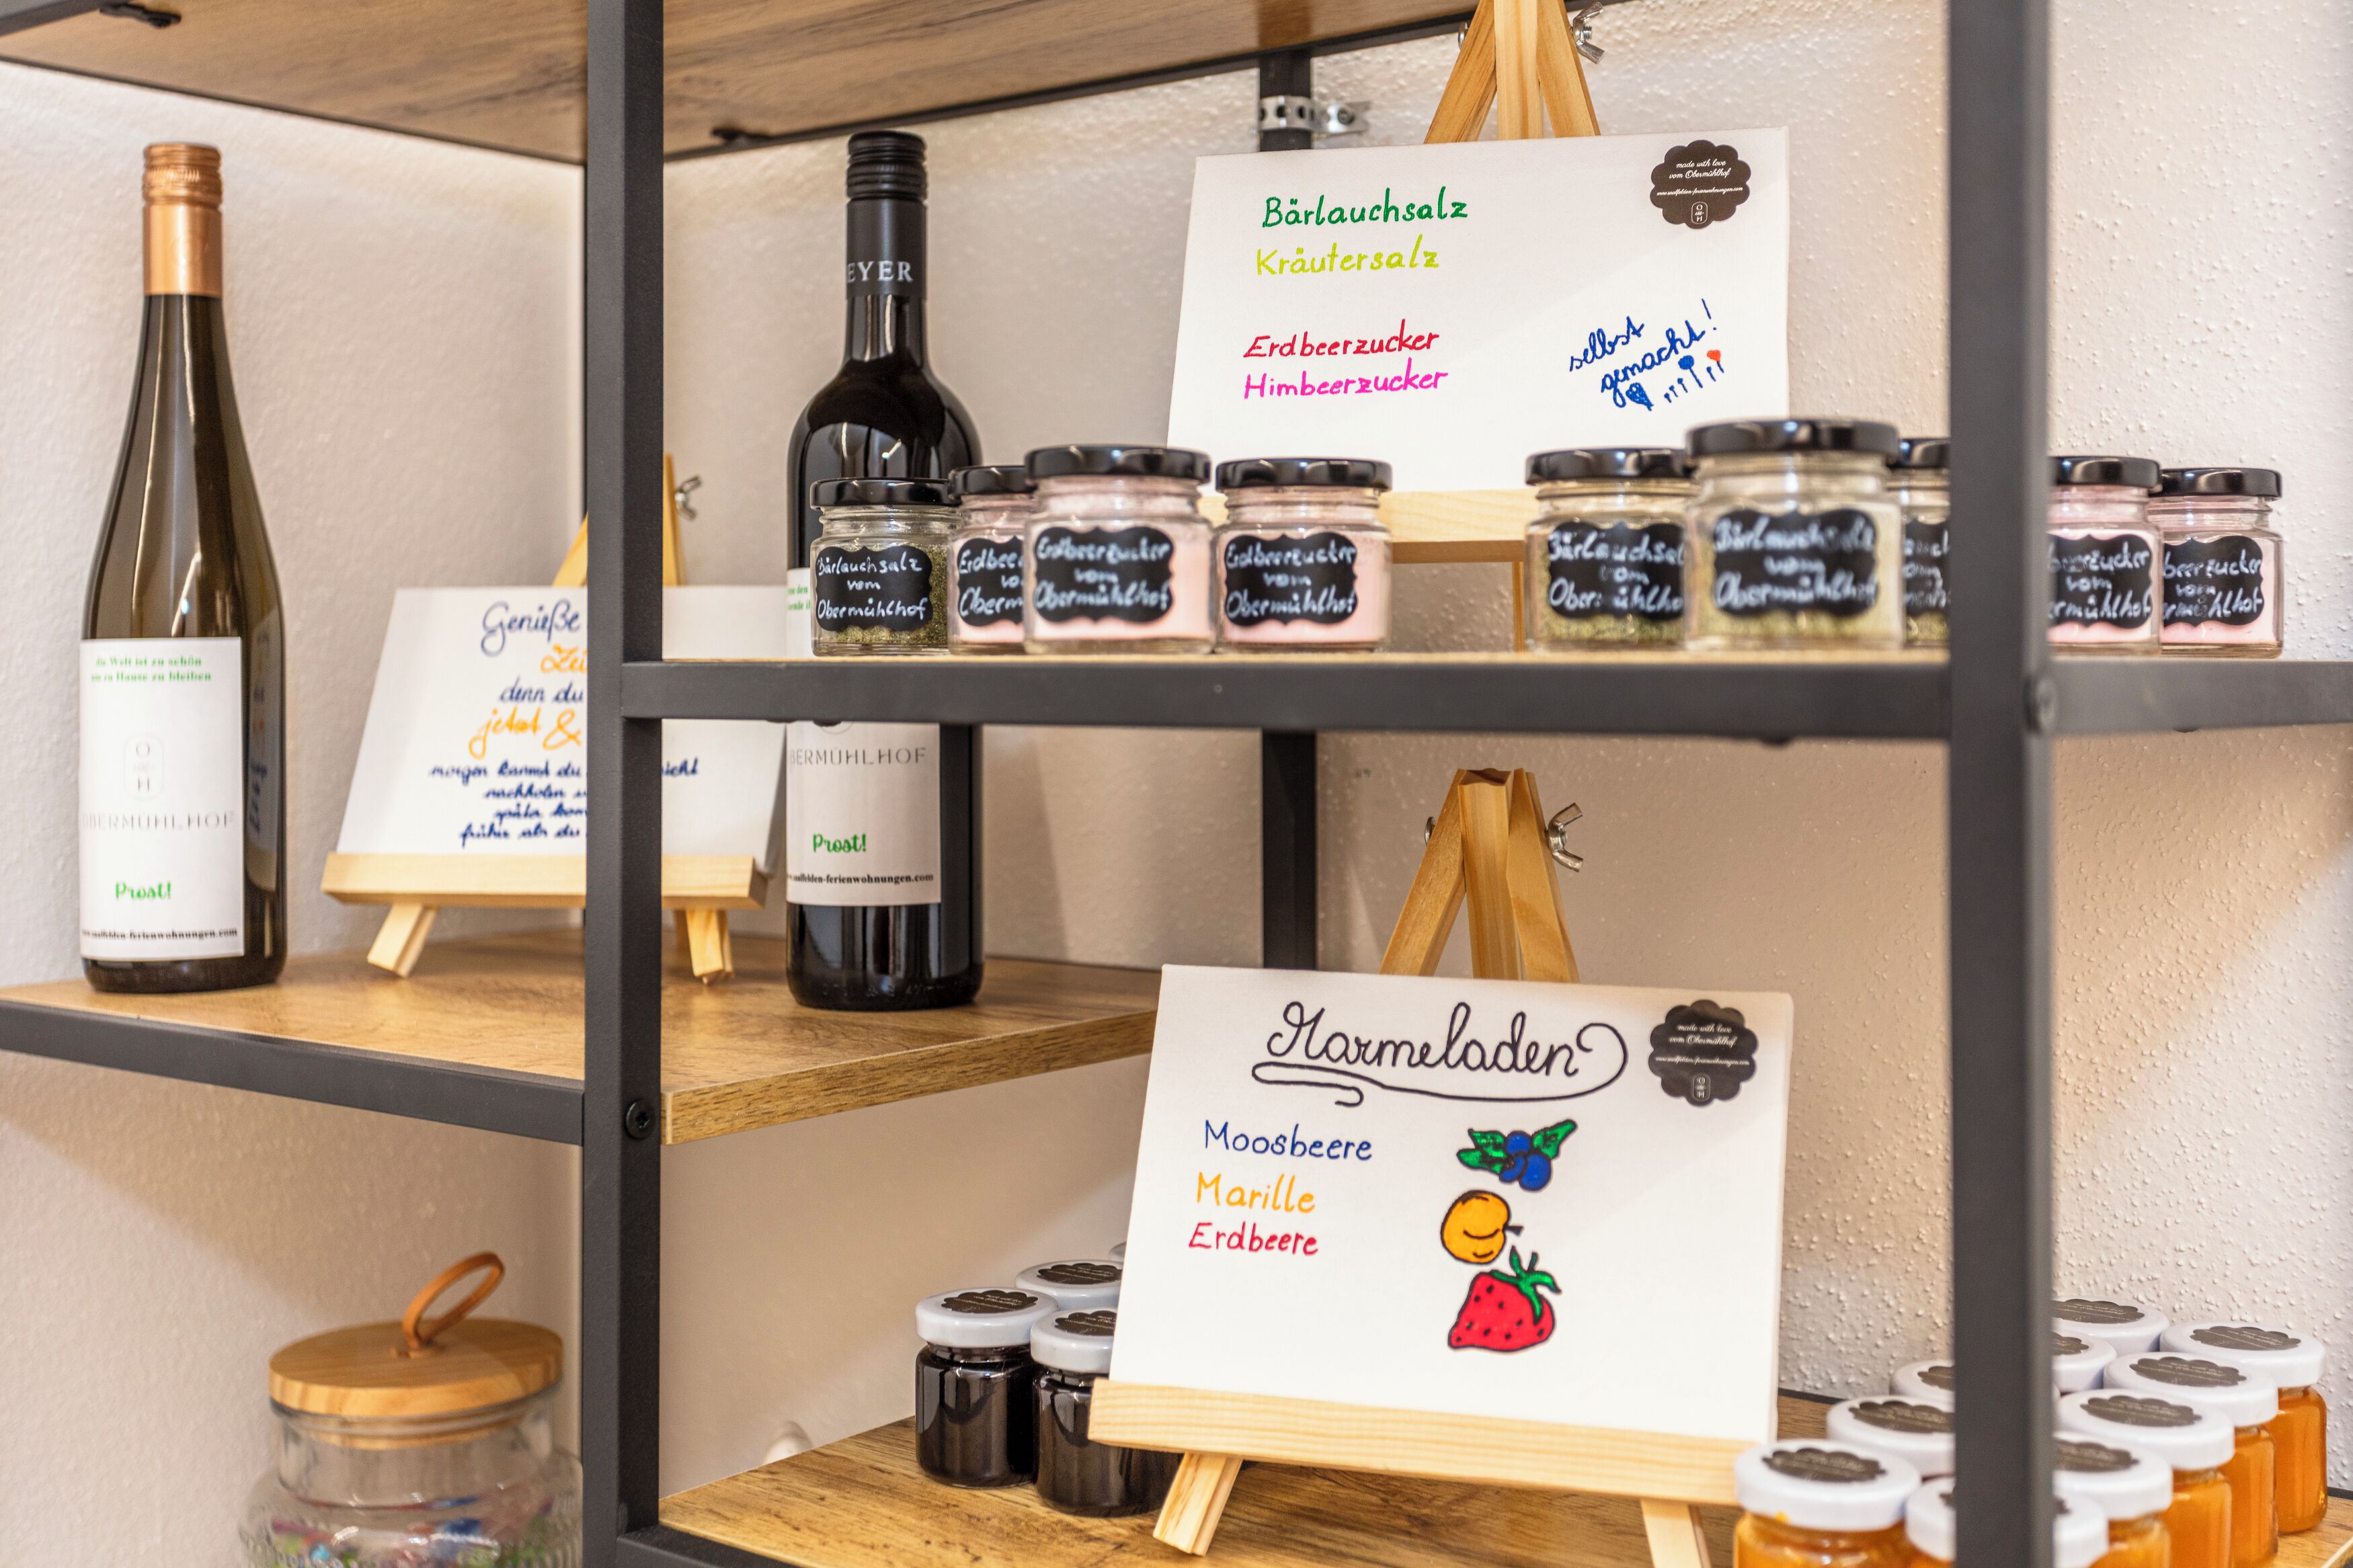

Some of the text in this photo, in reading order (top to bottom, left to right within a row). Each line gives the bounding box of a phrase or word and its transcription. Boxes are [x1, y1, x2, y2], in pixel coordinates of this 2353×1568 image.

[1676, 158, 1726, 168] made with love
[1685, 167, 1732, 179] Obermühlhof
[1261, 186, 1468, 228] Bärlauchsalz
[1256, 233, 1440, 276] Kräutersalz
[1243, 319, 1440, 358] Erdbeerzucker
[1569, 315, 1645, 372] selbst
[1244, 357, 1449, 399] Himbeerzucker
[1548, 530, 1685, 567] Bärlauchsal
[959, 547, 1023, 575] Erdbee
[846, 579, 881, 591] vom
[1000, 574, 1023, 589] vo
[1074, 567, 1119, 584] vom
[1262, 572, 1312, 588] vom
[2065, 575, 2112, 592] vom
[817, 597, 928, 620] Obermühlhof
[481, 597, 582, 658] Genieße
[540, 643, 588, 674] Zei
[169, 670, 212, 682] bleiben
[553, 679, 584, 703] du
[790, 747, 926, 766] BERMÜHLHOF
[813, 833, 867, 853] Prost!
[115, 881, 172, 901] Prost!
[1267, 1001, 1580, 1077] Marmeladen
[1700, 1024, 1716, 1032] with
[1716, 1024, 1732, 1033] love
[1203, 1118, 1373, 1162] Moosbeere
[1196, 1171, 1316, 1214] Marille
[1187, 1221, 1319, 1257] Erdbeere
